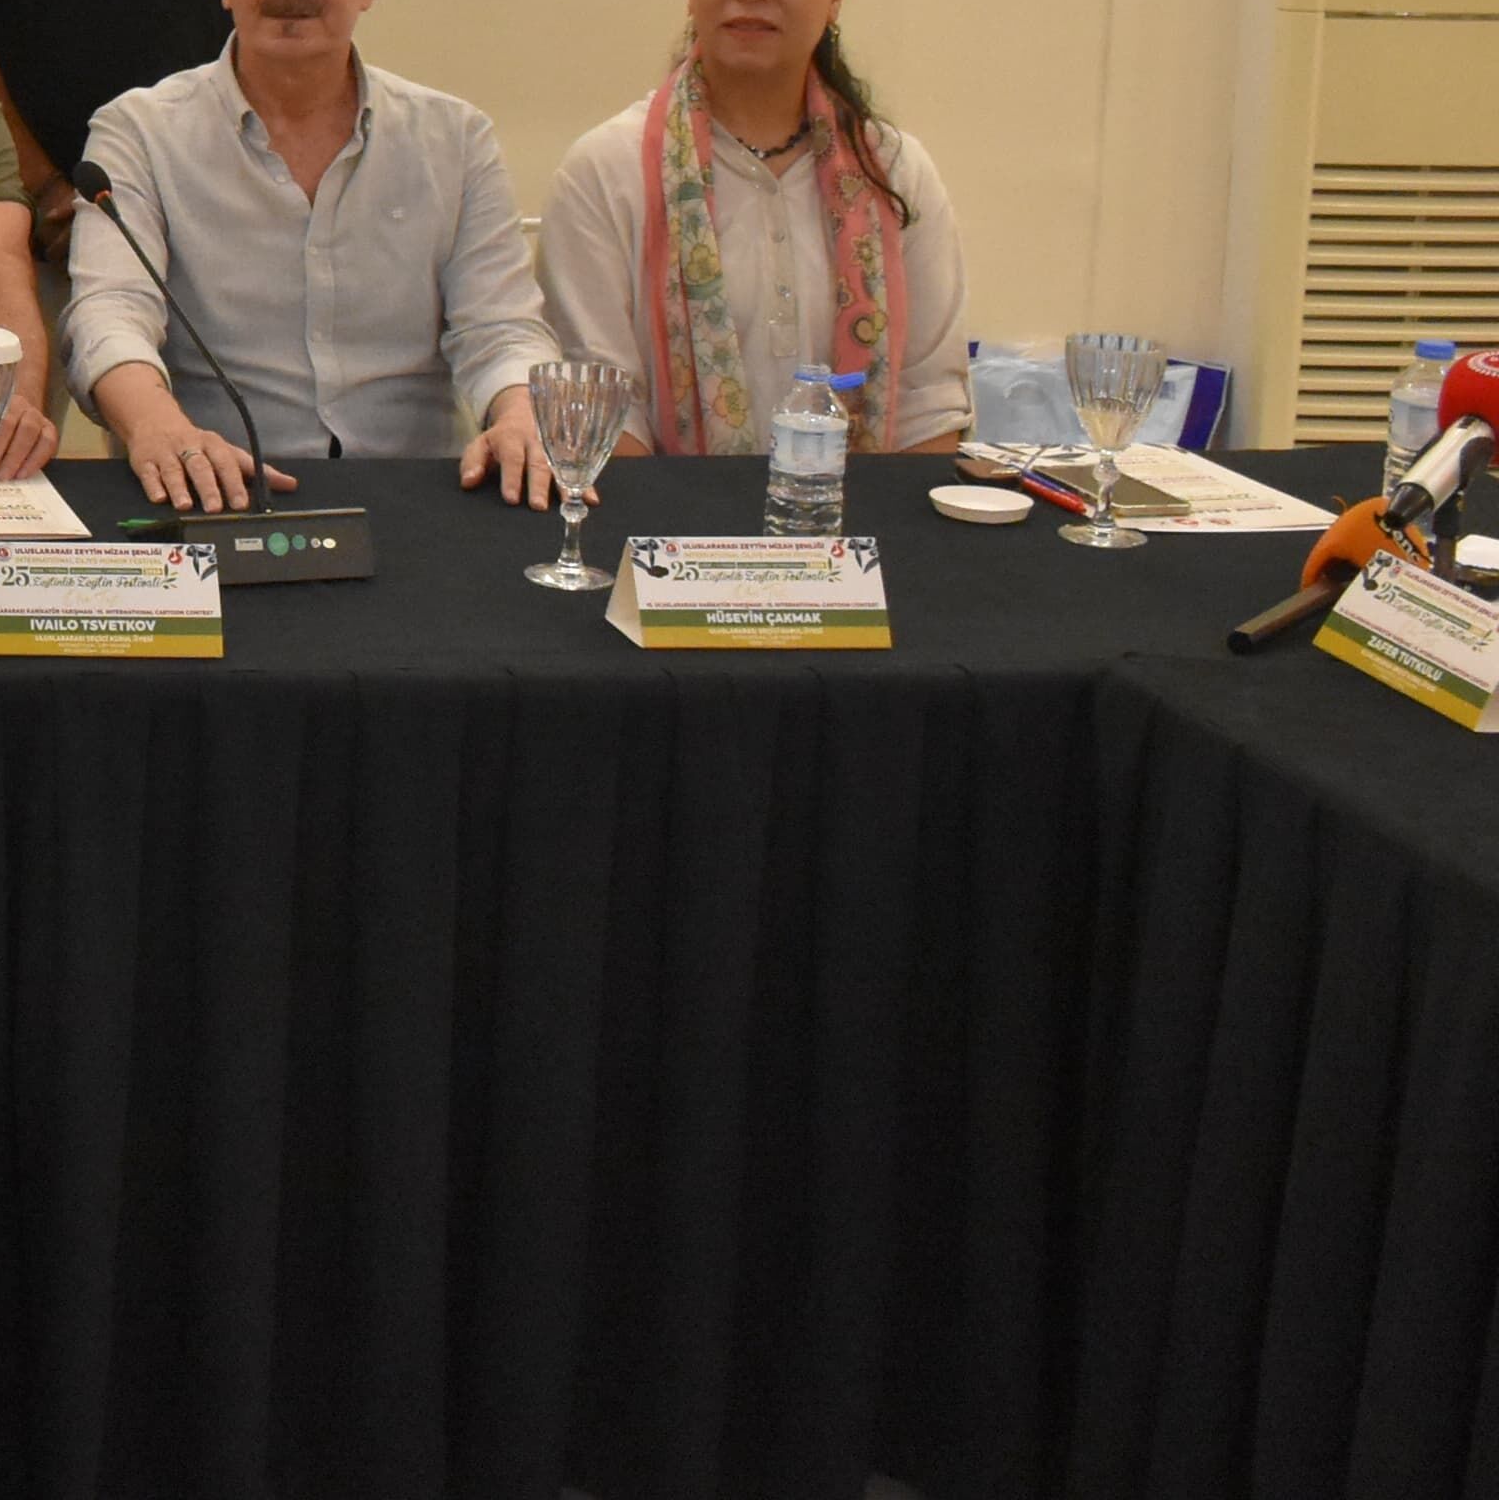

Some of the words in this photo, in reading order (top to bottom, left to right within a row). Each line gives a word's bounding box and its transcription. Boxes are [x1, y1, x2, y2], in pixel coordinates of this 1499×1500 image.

[30, 618, 78, 631] IVAILO
[80, 619, 156, 632] TSVETKOV
[706, 609, 763, 624] HÜSEYİN
[766, 612, 822, 626] ÇAKMAK
